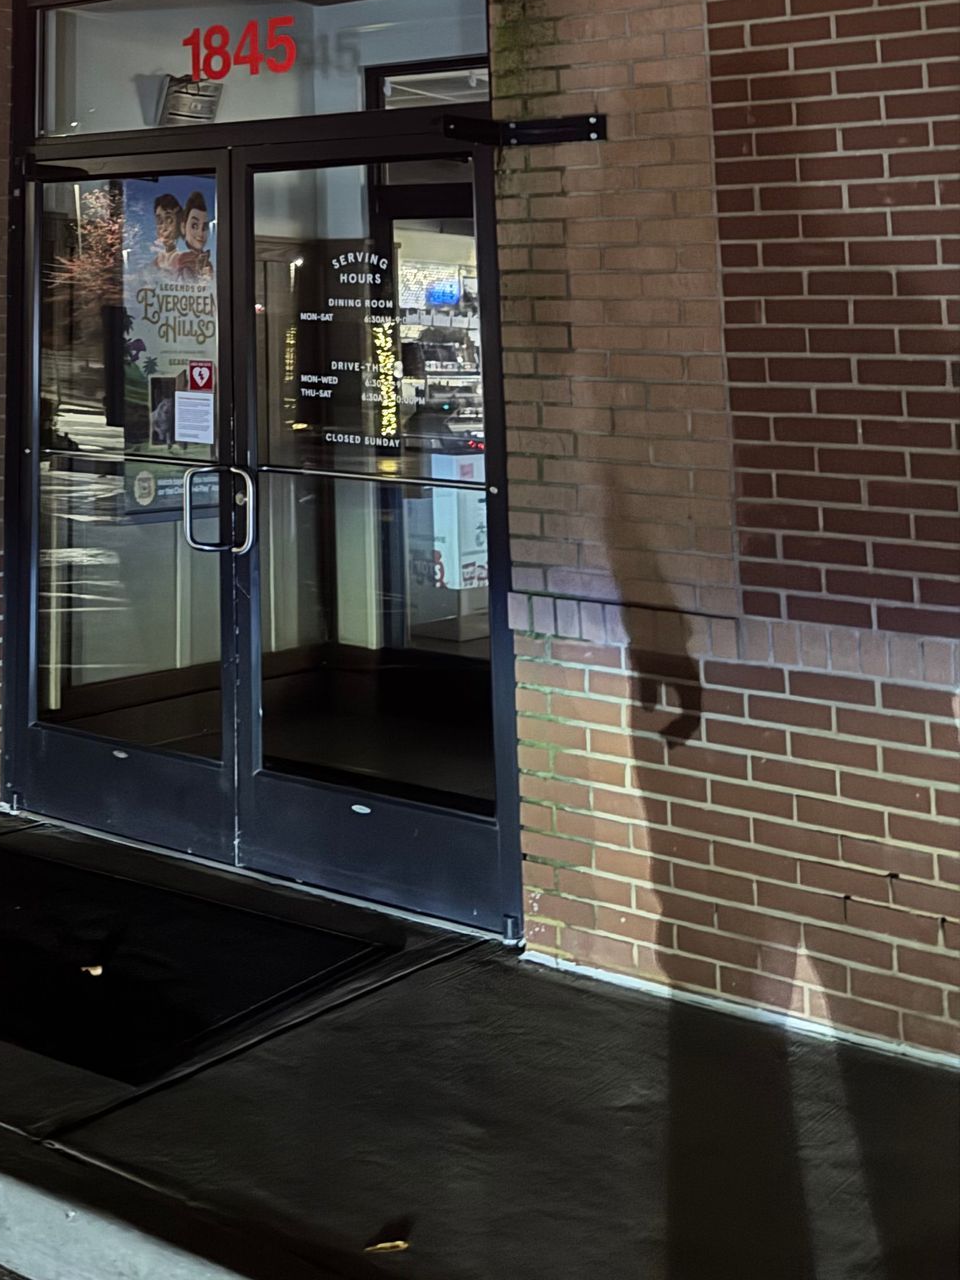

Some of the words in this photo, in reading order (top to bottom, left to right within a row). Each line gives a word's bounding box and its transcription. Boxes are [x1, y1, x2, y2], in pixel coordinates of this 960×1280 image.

[182, 15, 297, 82] 1845
[331, 251, 389, 270] SERVING
[339, 273, 382, 284] HOURS
[160, 283, 195, 292] LEGENDS
[196, 285, 207, 293] OF
[328, 298, 362, 308] DINING
[364, 299, 394, 309] ROOM
[300, 312, 334, 322] MON-SAT
[158, 316, 216, 345] HILLS
[331, 361, 388, 373] DRIVE-TH
[300, 374, 339, 385] MON-WED
[300, 388, 333, 398] THU-SAT
[325, 433, 361, 444] CLOSED
[364, 436, 400, 448] SUNDAY
